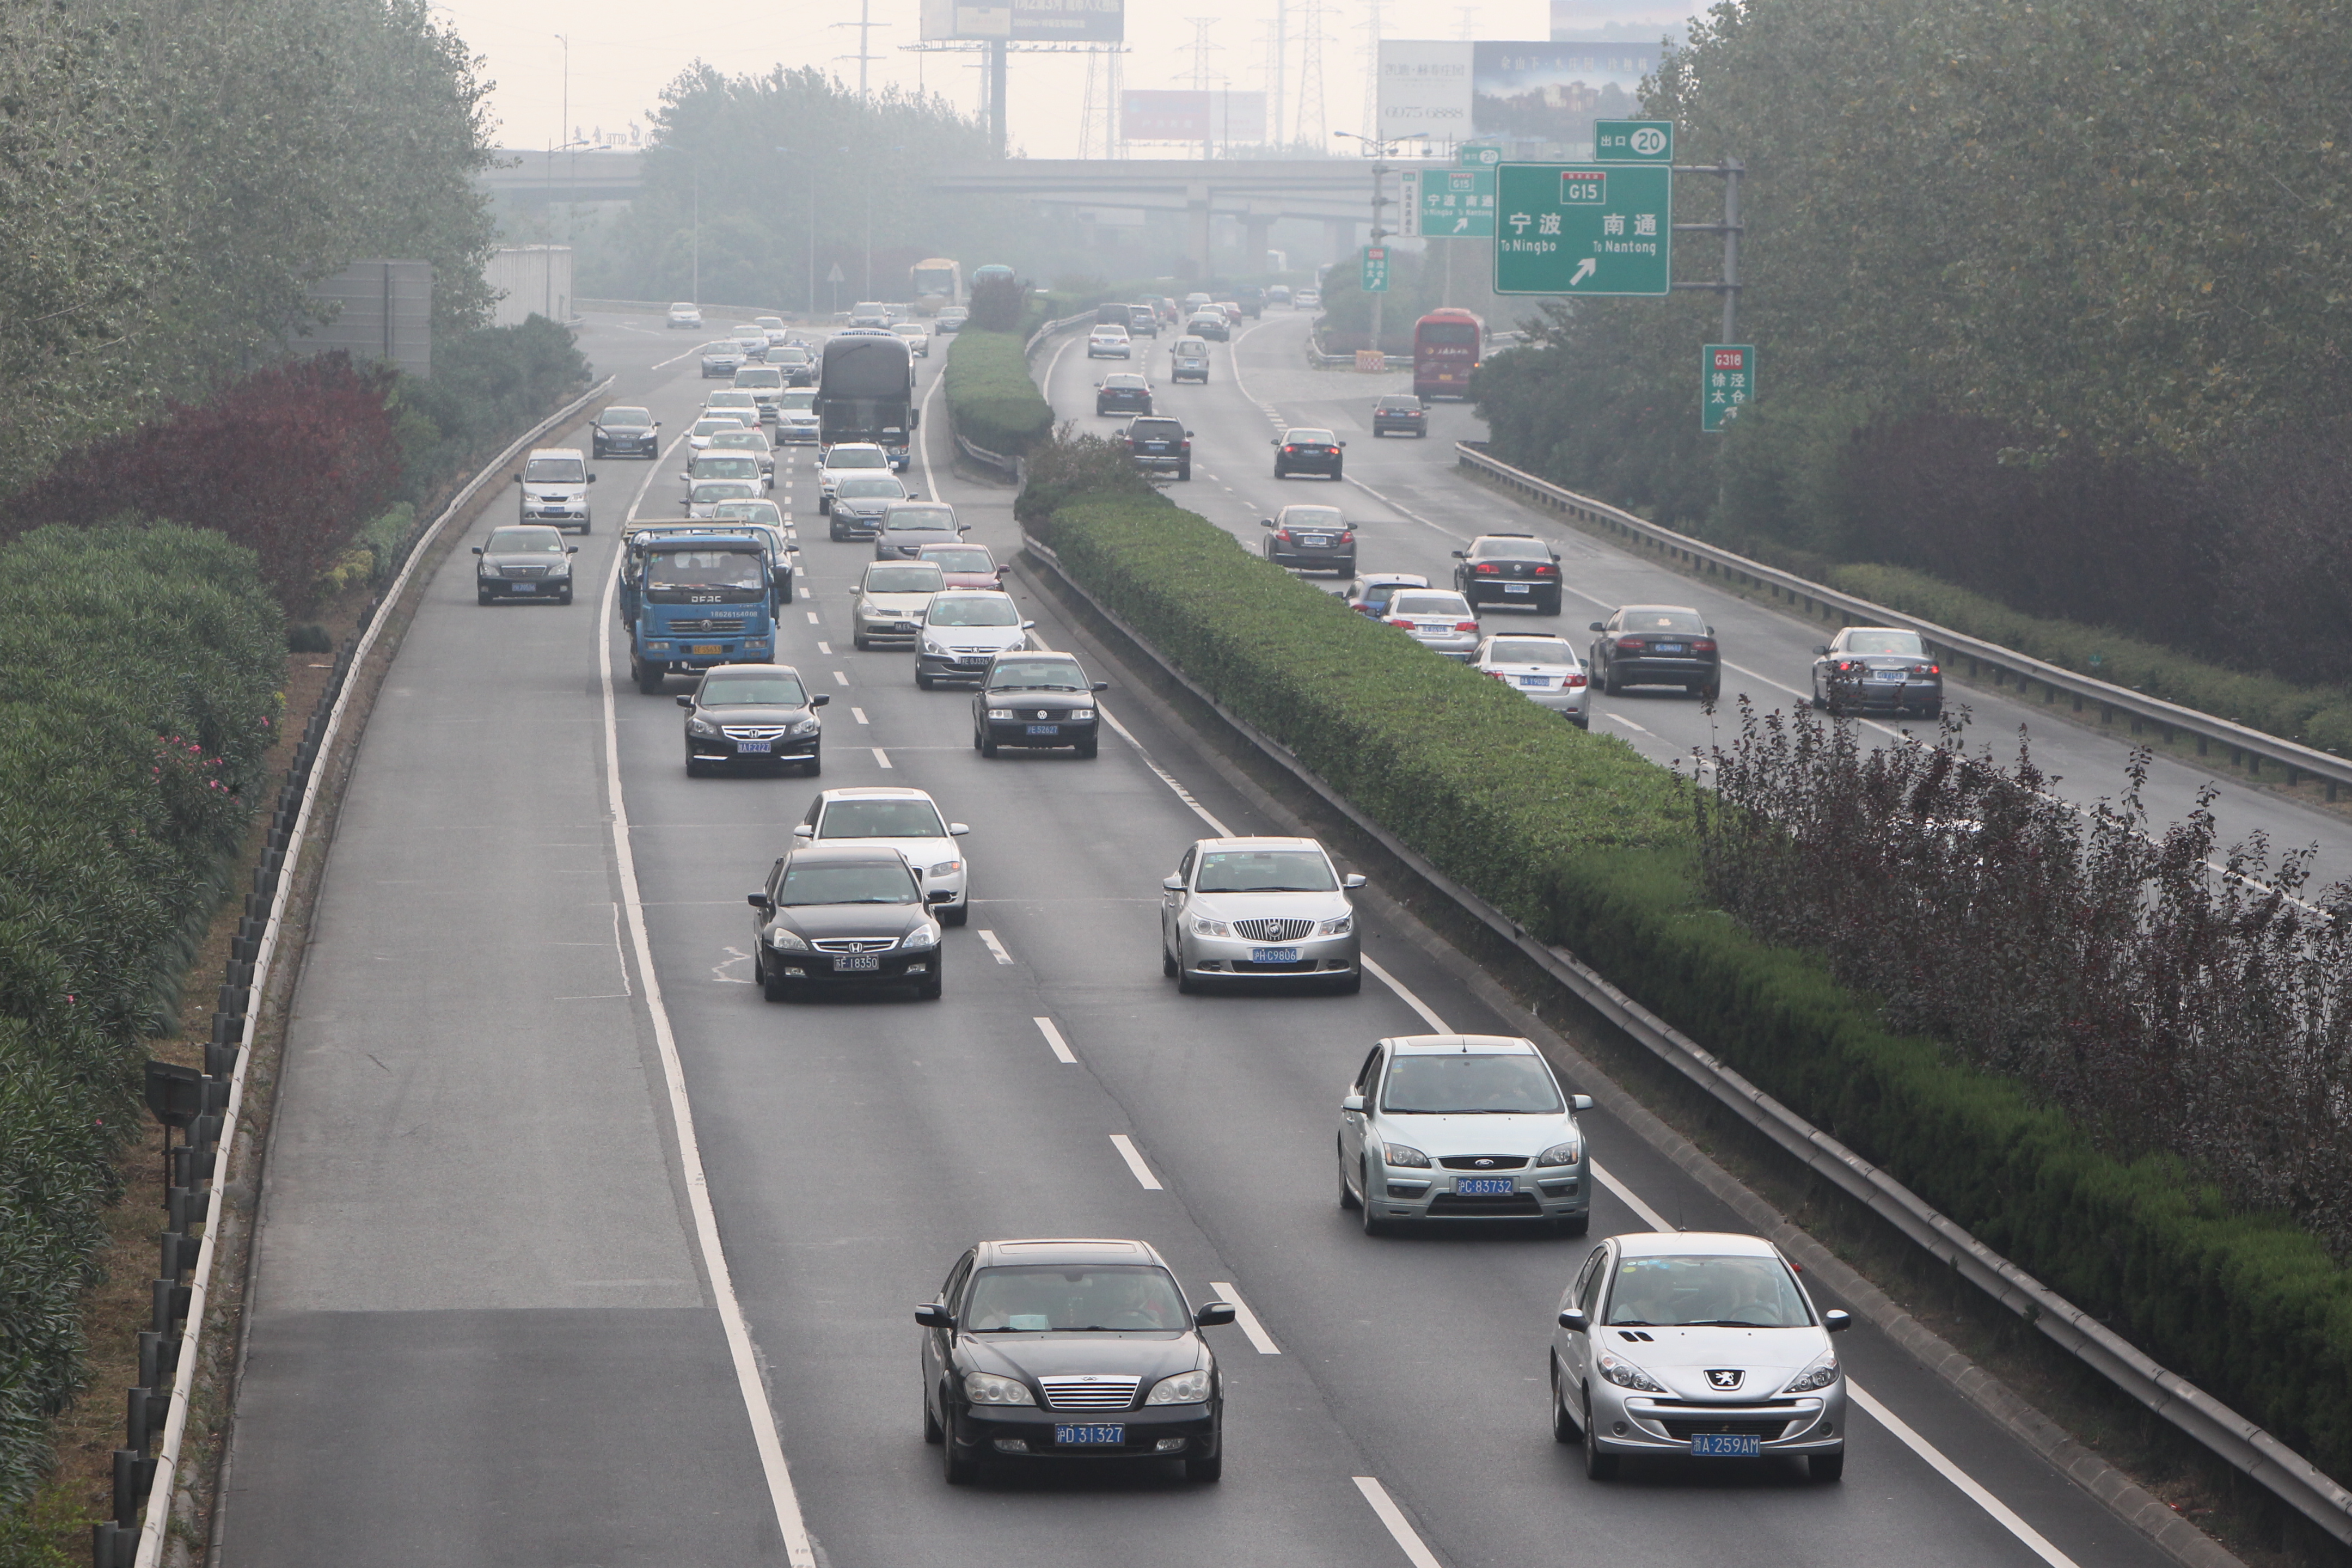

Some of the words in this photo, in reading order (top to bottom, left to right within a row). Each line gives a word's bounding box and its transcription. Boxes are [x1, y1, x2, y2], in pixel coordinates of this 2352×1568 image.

[1426, 107, 1463, 118] 6888
[1601, 135, 1626, 146] 出口
[1638, 132, 1660, 150] 20
[1453, 180, 1469, 188] G15
[1569, 184, 1597, 199] G15
[1509, 212, 1561, 235] 宁波
[1603, 213, 1657, 236] 南通
[1501, 240, 1510, 252] To
[1513, 240, 1557, 255] Ningbo
[1594, 241, 1602, 252] To
[1606, 241, 1656, 255] Nantong
[1716, 354, 1742, 366] G318
[1712, 372, 1745, 387] 徐泾
[1711, 389, 1745, 403] 太仓
